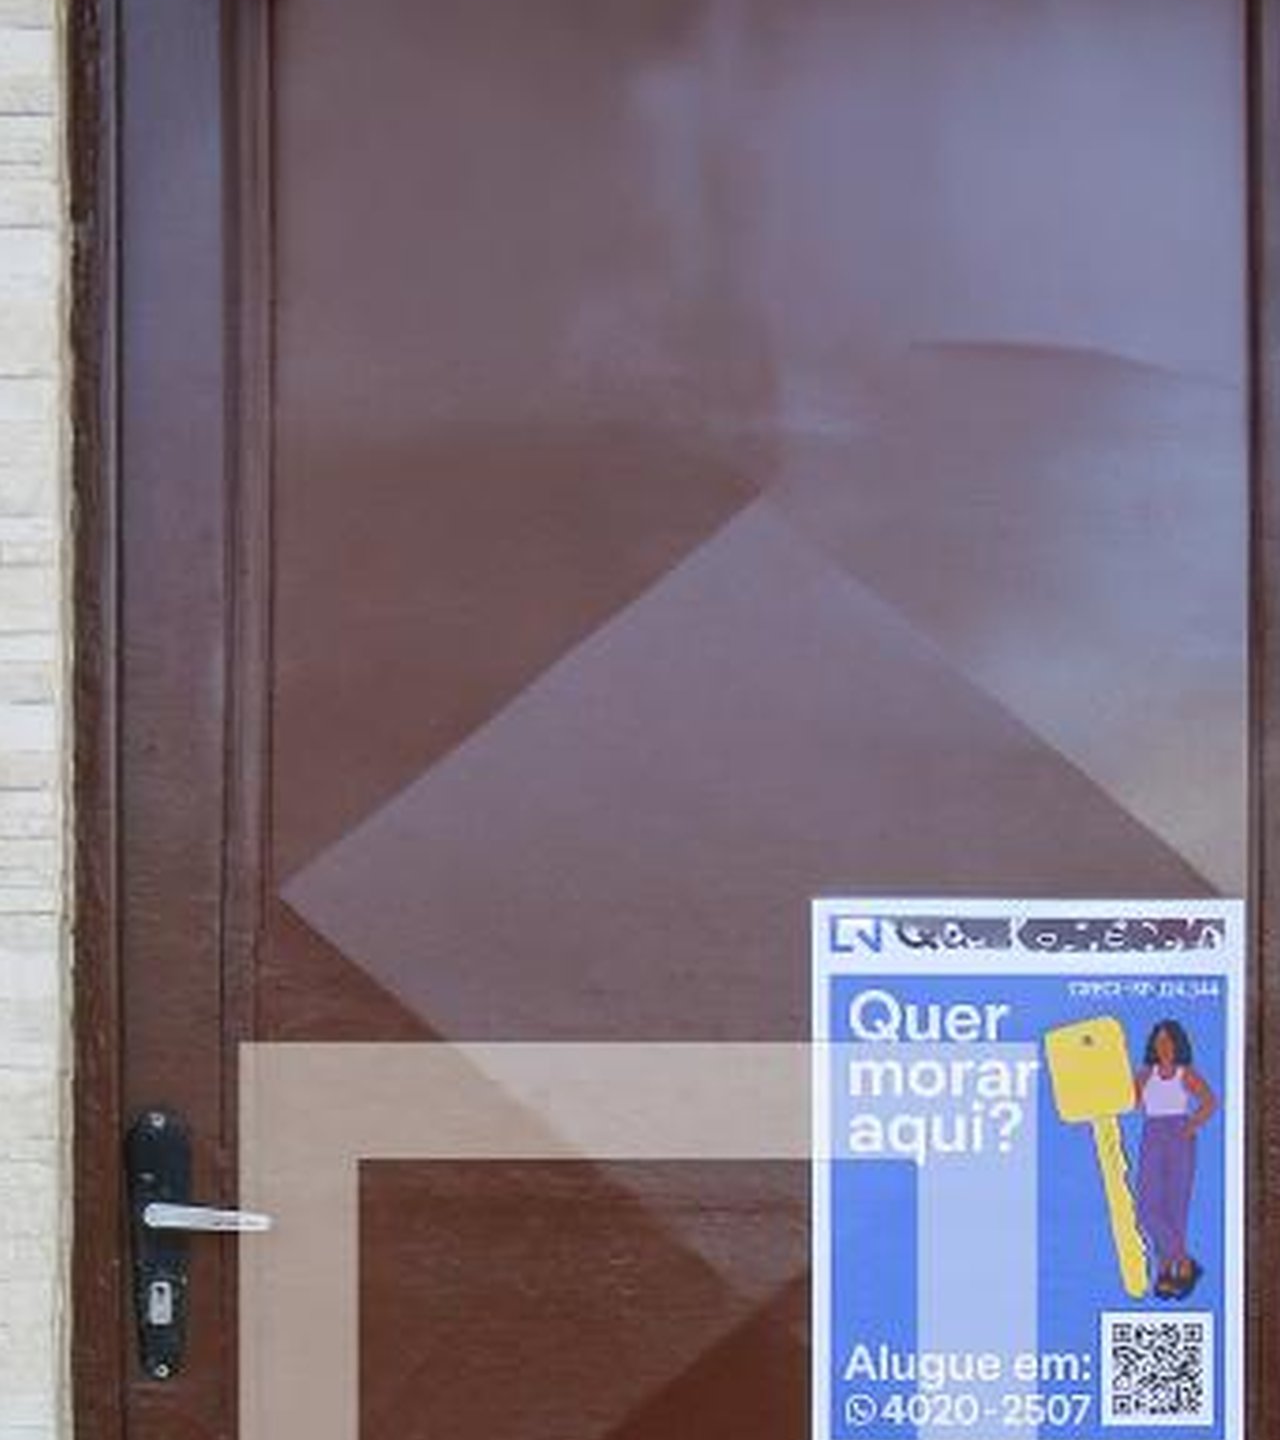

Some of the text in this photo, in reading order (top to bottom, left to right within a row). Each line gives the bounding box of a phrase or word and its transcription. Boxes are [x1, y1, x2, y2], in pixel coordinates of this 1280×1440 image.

[848, 989, 1011, 1043] Quer
[848, 1057, 1039, 1097] morar
[848, 1102, 1024, 1165] aqui?
[843, 1344, 1092, 1389] Alugue em:
